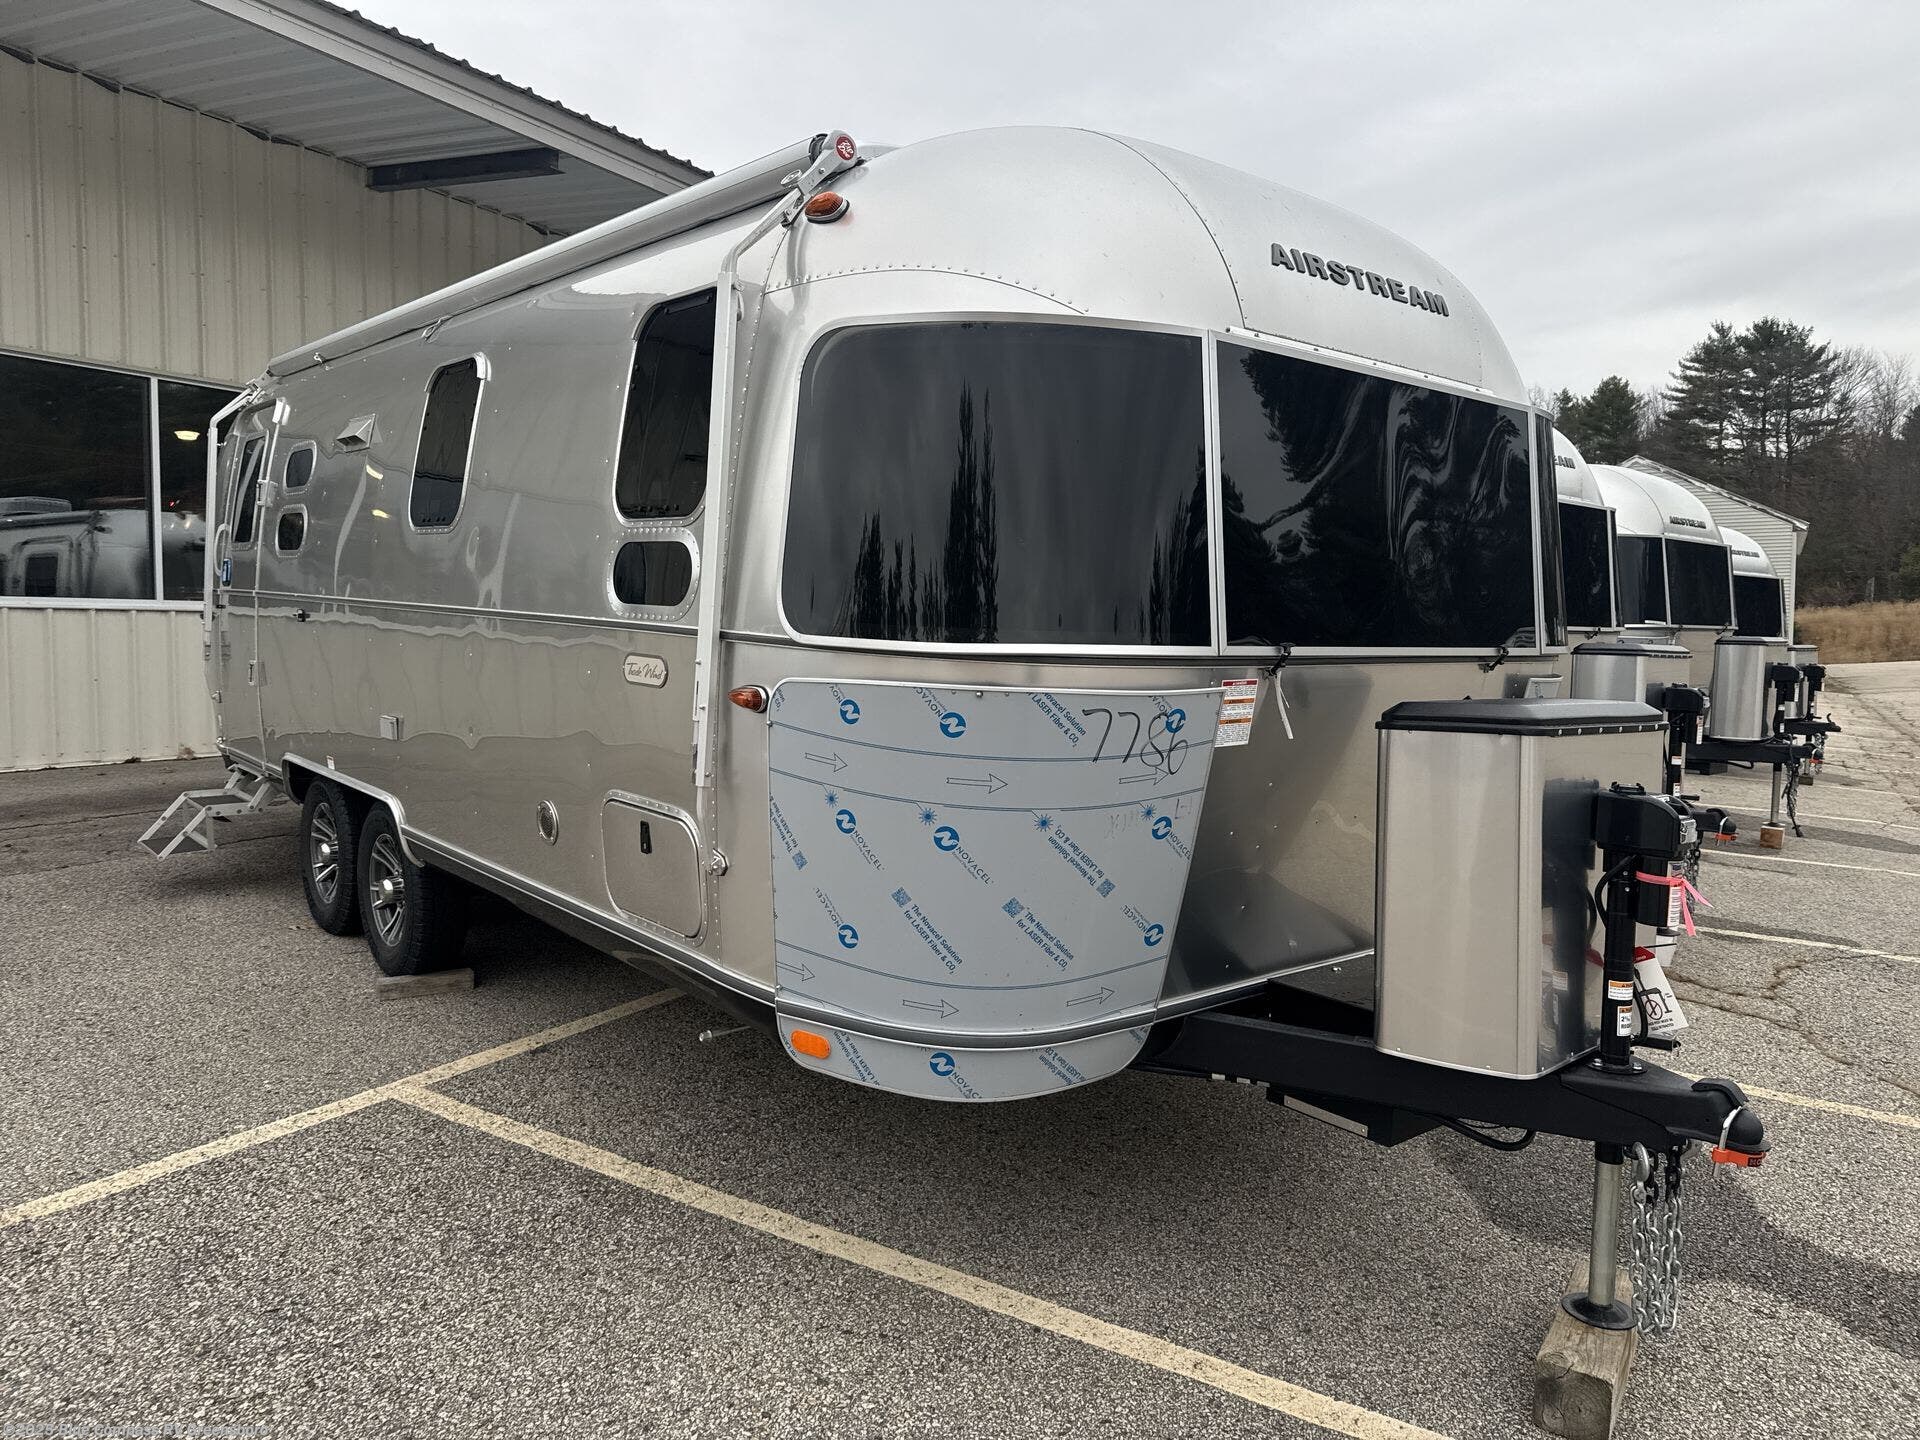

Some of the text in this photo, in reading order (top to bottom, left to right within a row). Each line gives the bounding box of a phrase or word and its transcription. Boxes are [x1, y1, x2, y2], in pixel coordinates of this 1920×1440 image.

[1271, 243, 1449, 317] AIRSTREAM
[914, 686, 943, 716] NOVAC
[1031, 694, 1052, 715] LASER
[1049, 712, 1066, 729] Fiber
[1062, 710, 1087, 735] Solution
[1082, 707, 1188, 775] 7786
[851, 830, 883, 870] NOVACEL
[955, 845, 991, 884] NOVACEL
[1045, 835, 1096, 885] The Novacel Solution
[1079, 853, 1098, 871] LASER
[814, 887, 840, 927] NOVACEL
[1121, 904, 1147, 932] NOVACEL
[903, 909, 913, 920] for
[910, 919, 930, 940] LASER
[926, 939, 943, 956] Fiber
[910, 903, 963, 964] The Novacel Solution
[1015, 919, 1027, 930] for
[1023, 927, 1043, 945] LASER
[1040, 942, 1055, 957] Fiber
[1024, 911, 1075, 960] The Novacel Solution
